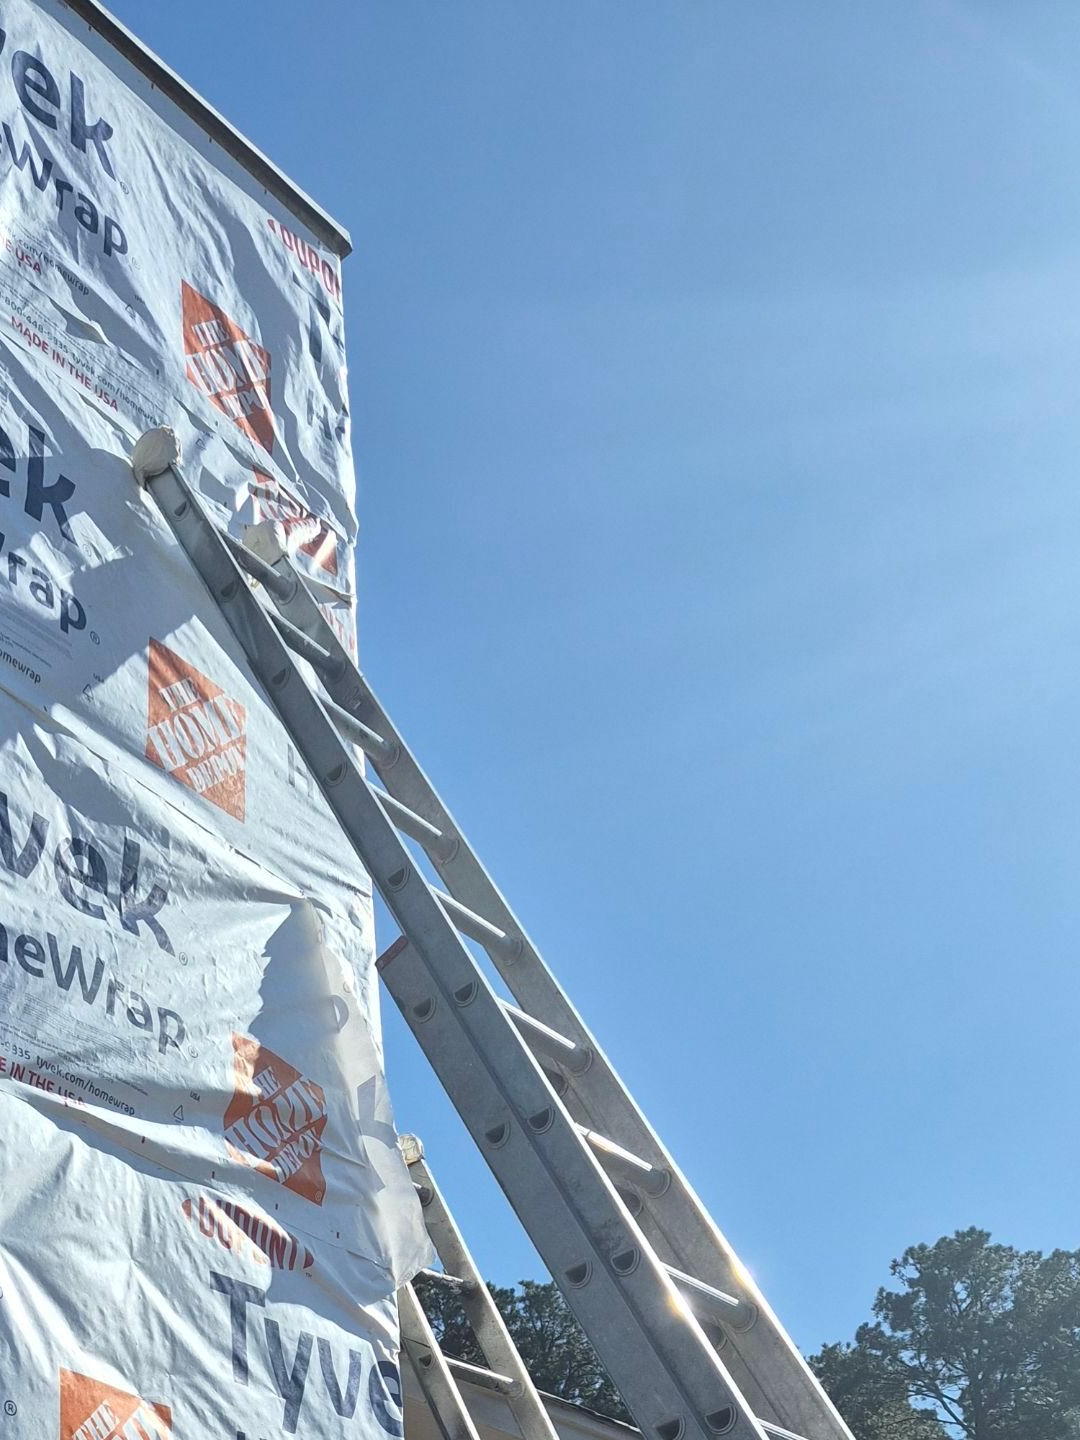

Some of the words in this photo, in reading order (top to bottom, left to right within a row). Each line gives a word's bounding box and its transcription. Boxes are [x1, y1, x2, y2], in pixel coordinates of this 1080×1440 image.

[15, 247, 42, 276] USA
[10, 315, 49, 355] MADE
[51, 347, 66, 370] IN
[68, 361, 92, 391] THE
[94, 385, 119, 413] USA
[10, 1061, 25, 1081] IN
[28, 1070, 54, 1094] THE
[36, 1055, 135, 1117] tyvek.com/homewrap
[199, 1196, 300, 1271] DUPONT
[209, 1270, 404, 1438] Tyve
